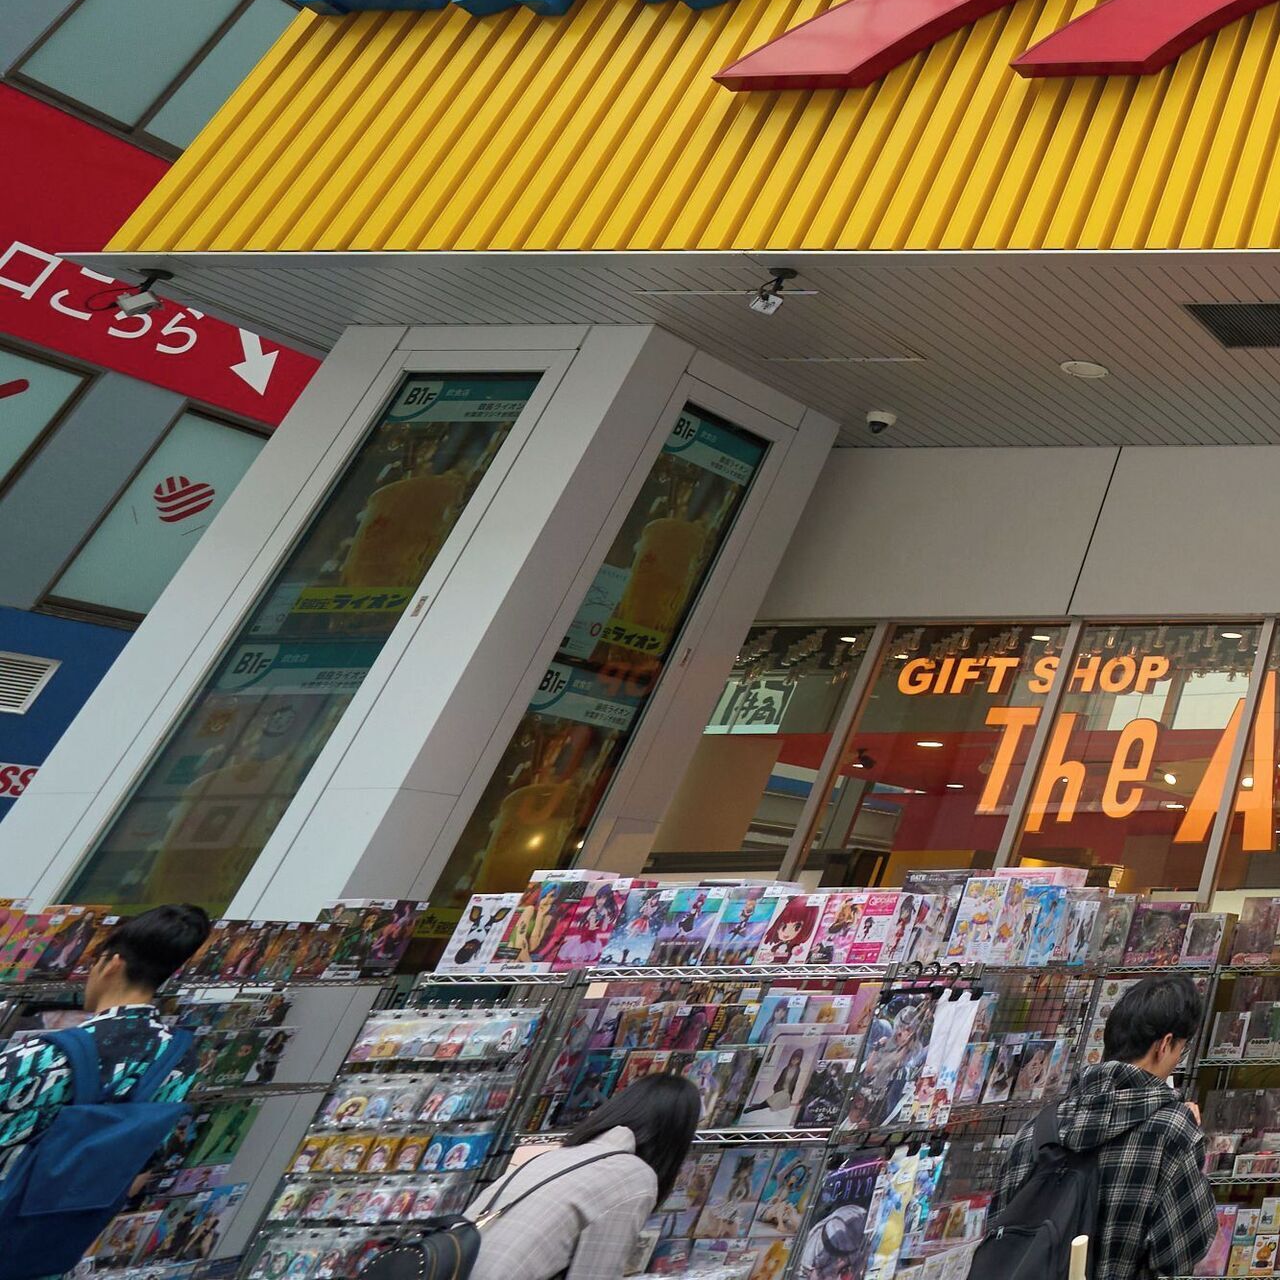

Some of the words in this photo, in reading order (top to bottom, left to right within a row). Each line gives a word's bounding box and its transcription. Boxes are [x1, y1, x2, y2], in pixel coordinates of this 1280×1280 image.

[404, 386, 438, 410] B1F
[672, 418, 697, 442] B1F
[232, 651, 274, 676] B1F
[897, 657, 1021, 696] GIFT
[1027, 654, 1171, 695] SHOP
[538, 670, 566, 695] B1F
[974, 706, 1164, 834] The
